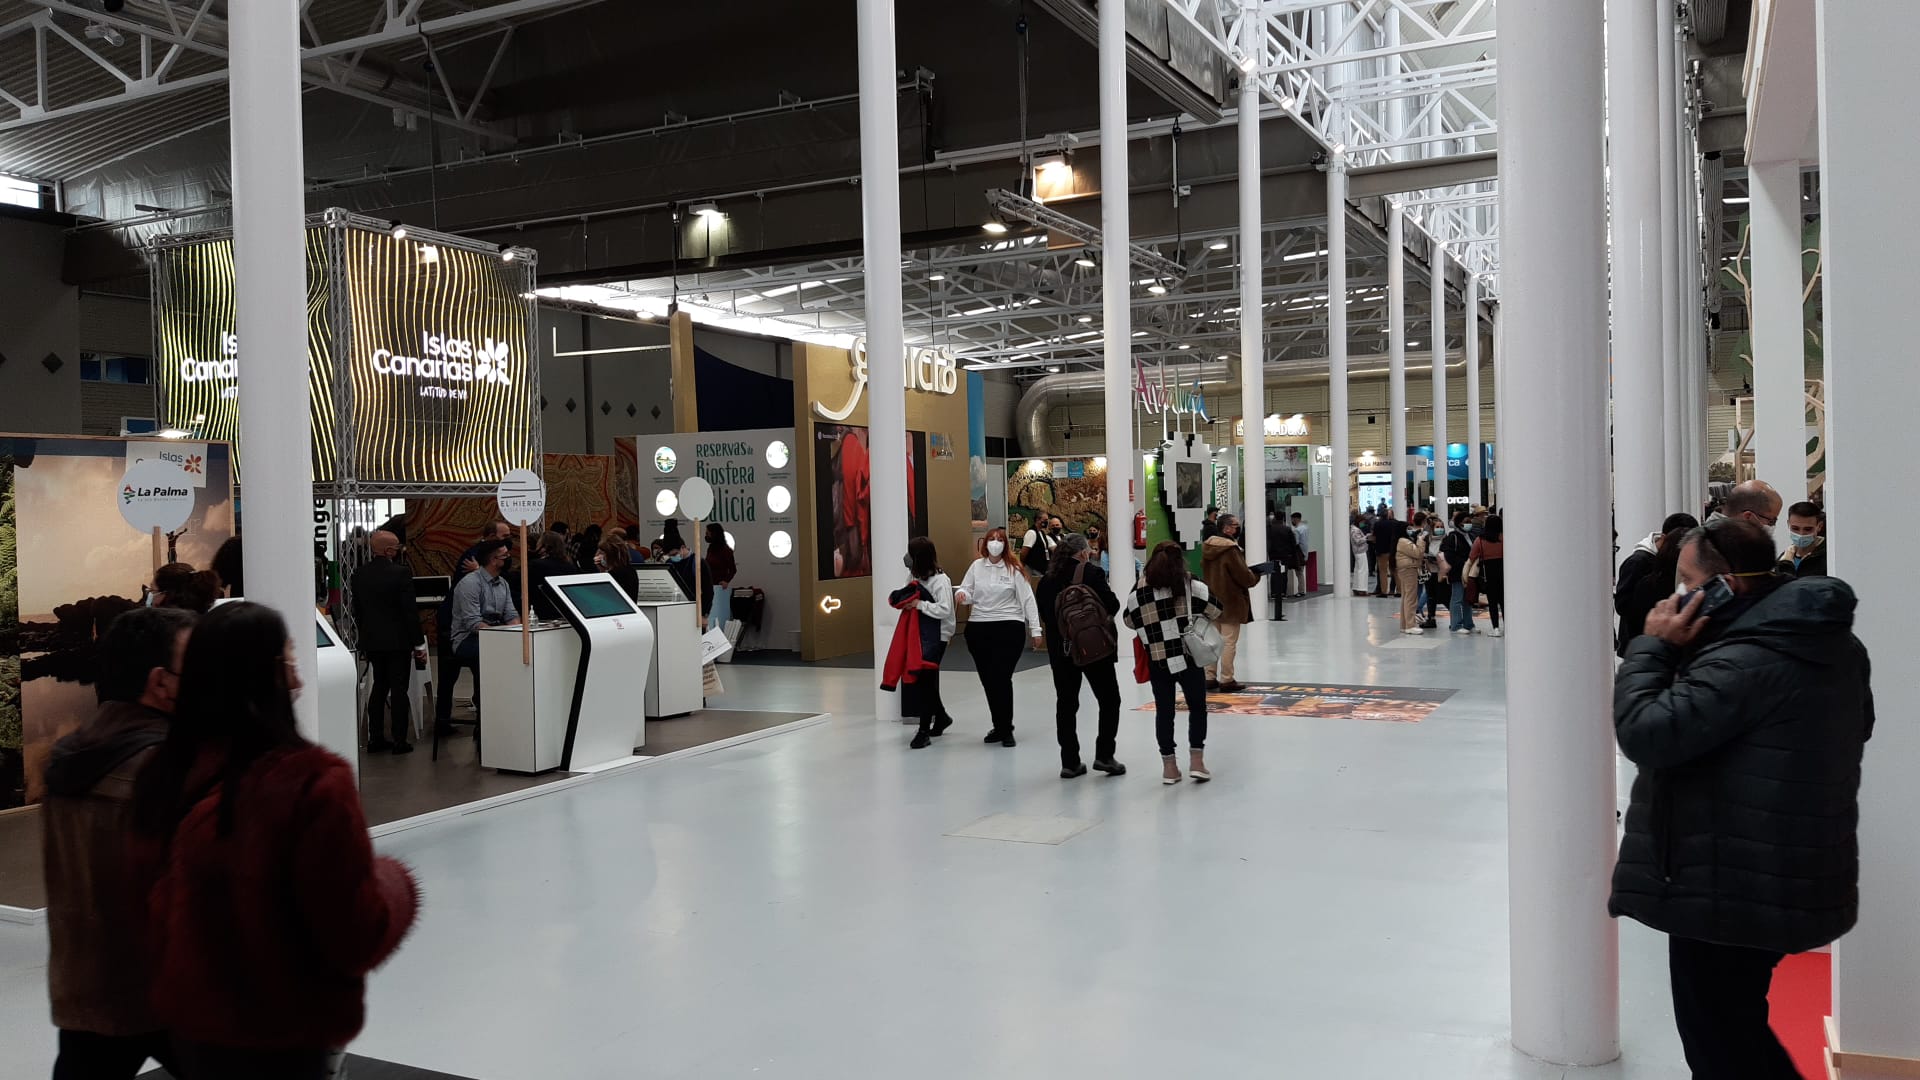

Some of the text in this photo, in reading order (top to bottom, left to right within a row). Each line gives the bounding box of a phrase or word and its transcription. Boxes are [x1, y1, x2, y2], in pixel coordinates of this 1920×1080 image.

[423, 330, 472, 359] Islas
[373, 349, 472, 381] Canarias
[160, 450, 183, 463] Islas
[696, 460, 754, 485] Biosfera
[138, 487, 188, 497] La Palma
[500, 500, 510, 508] EL
[700, 487, 755, 522] alicia
